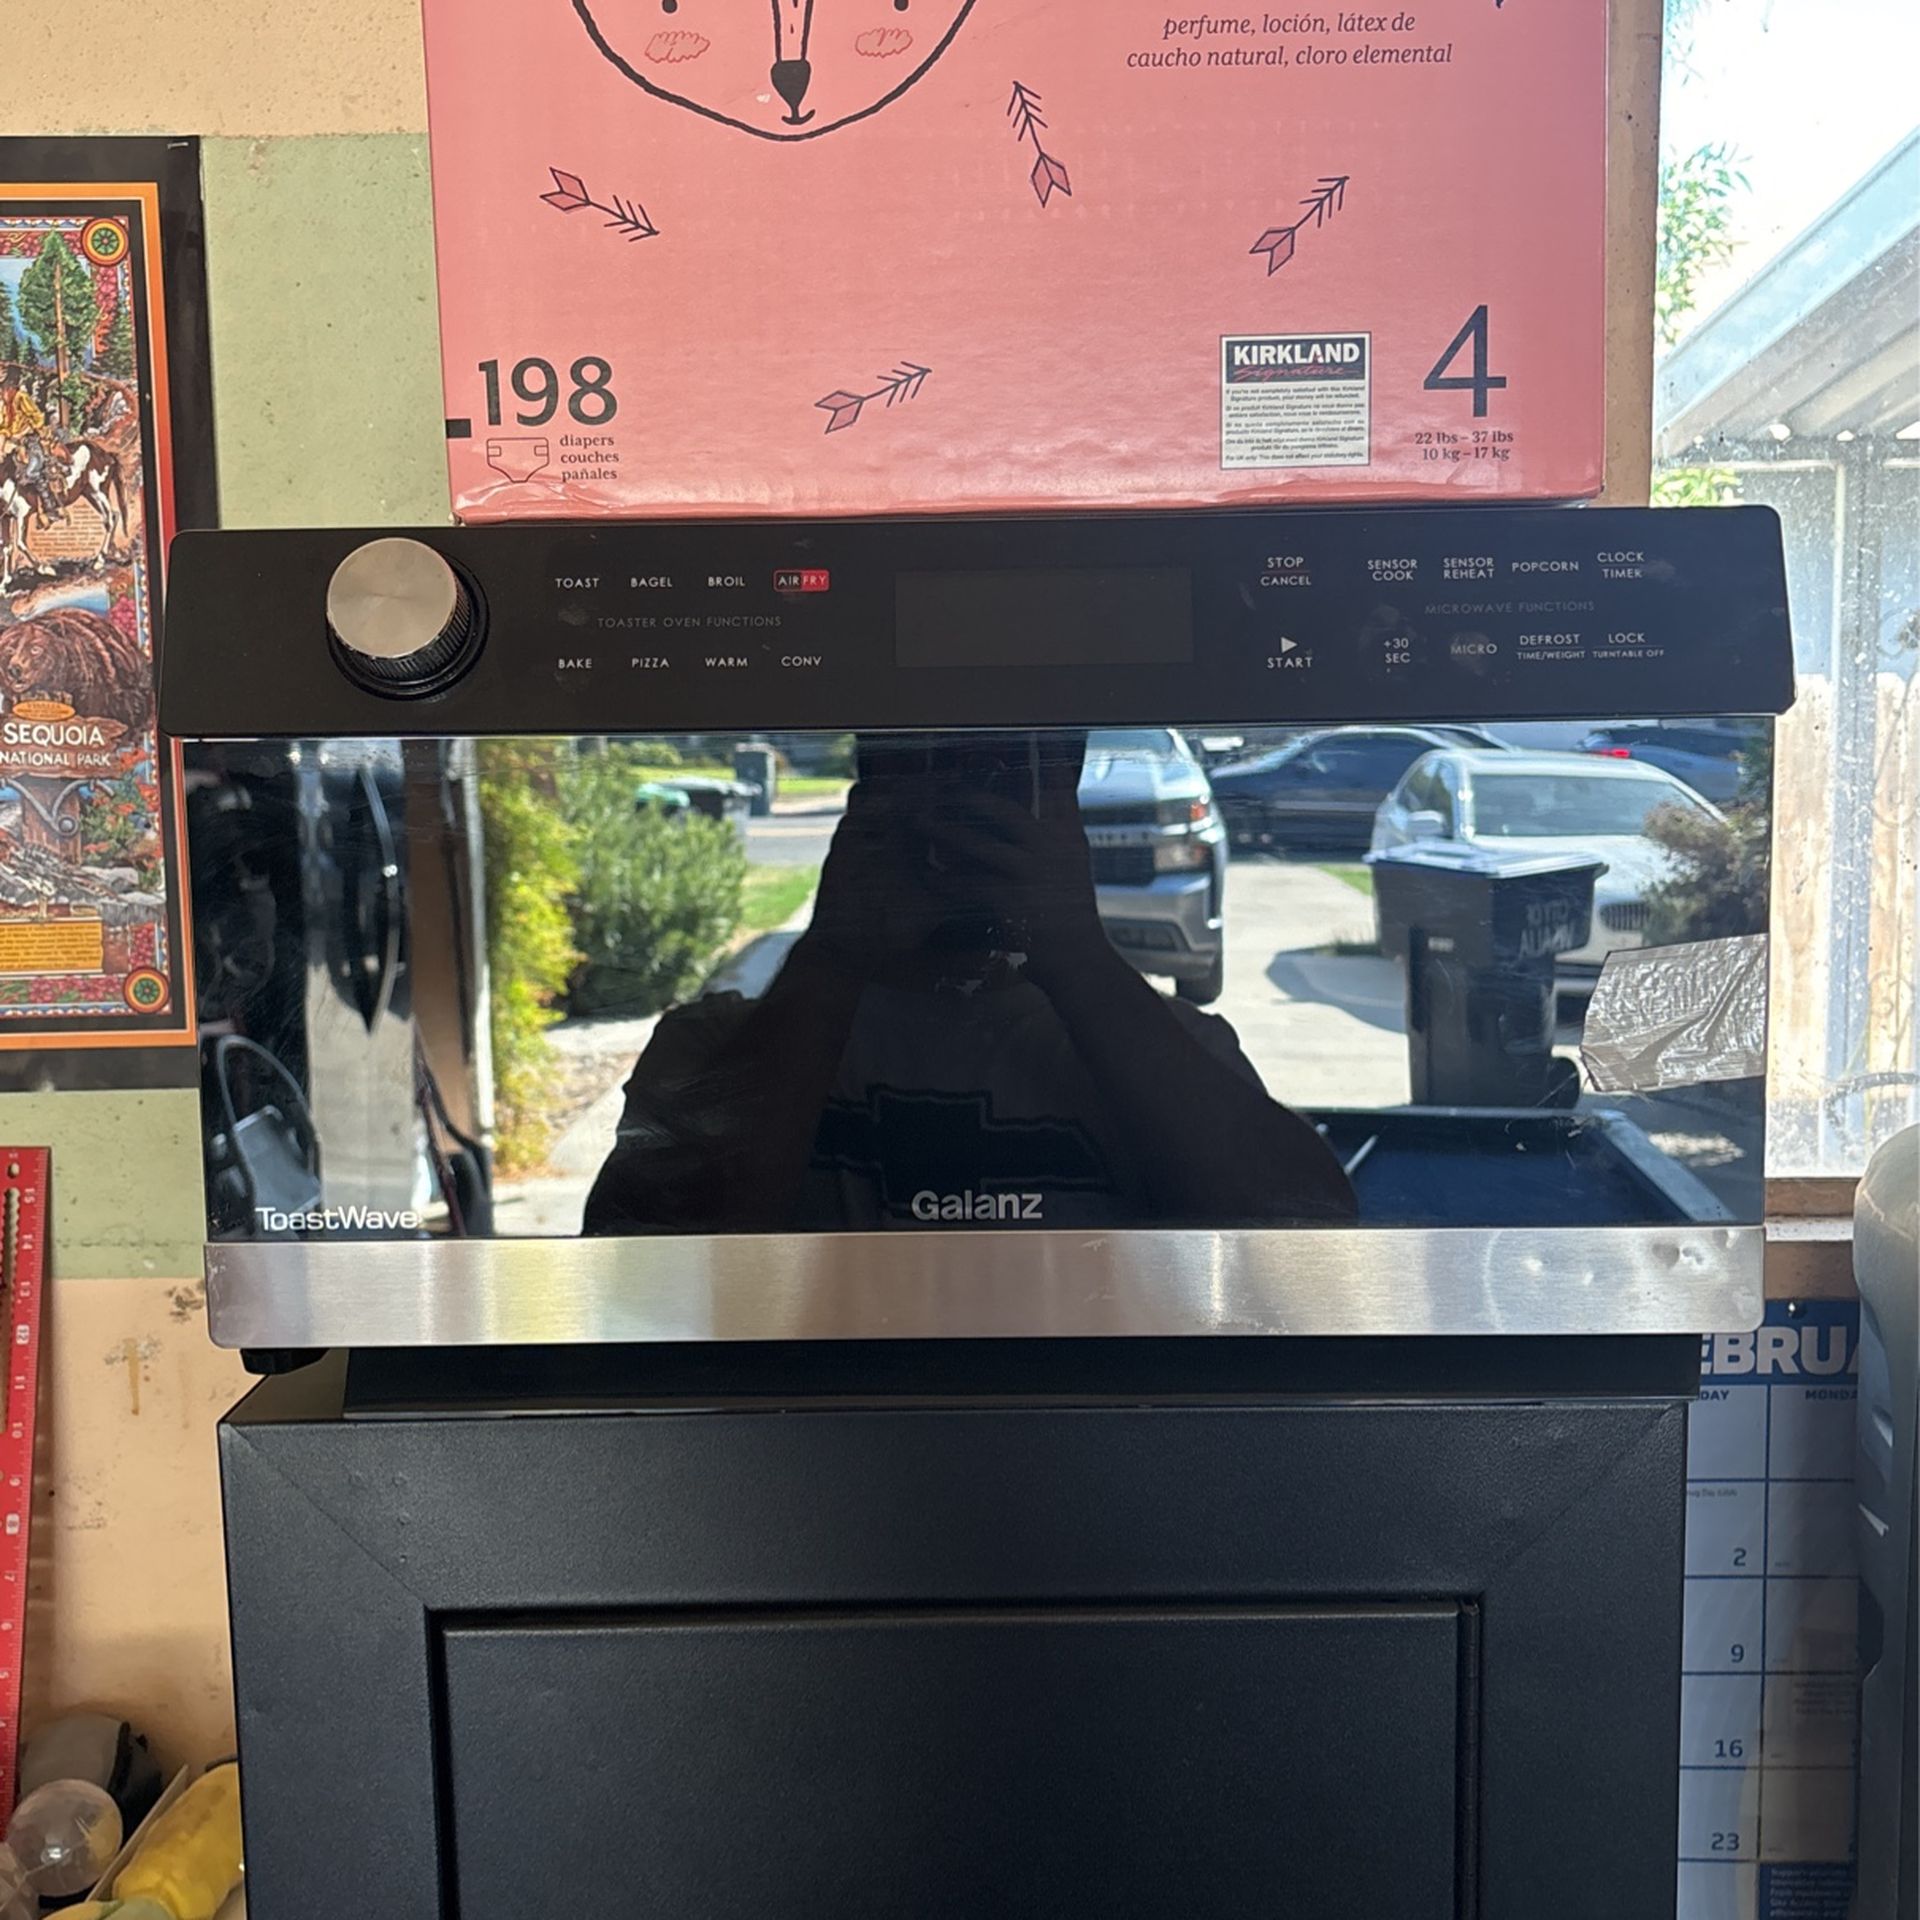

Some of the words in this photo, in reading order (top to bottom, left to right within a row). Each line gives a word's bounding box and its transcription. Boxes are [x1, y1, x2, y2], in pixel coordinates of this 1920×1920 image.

[1163, 14, 1256, 40] perfume,
[1262, 12, 1331, 35] loción,
[1338, 12, 1388, 33] látex
[1391, 12, 1416, 32] de
[1127, 47, 1202, 68] caucho
[1207, 46, 1289, 68] natural,
[1296, 45, 1347, 65] cloro
[1353, 44, 1452, 65] elemental
[1234, 342, 1360, 366] KIRKLAND
[1423, 304, 1507, 418] 4
[1234, 364, 1358, 383] Signature
[478, 356, 618, 427] 198
[559, 434, 615, 450] diapers
[1415, 432, 1432, 445] 22
[1436, 431, 1458, 445] lbs
[1472, 431, 1488, 444] 37
[1492, 430, 1514, 443] lbs
[560, 451, 620, 465] couches
[1423, 448, 1438, 460] 10
[1442, 447, 1461, 462] kg
[1475, 446, 1488, 459] 17
[1492, 446, 1510, 461] kg
[561, 468, 618, 483] pañales
[1267, 556, 1304, 569] STOP
[1443, 557, 1494, 568] SENSOR
[1597, 552, 1644, 563] CLOCK
[1367, 559, 1418, 570] SENSOR
[1512, 561, 1579, 572] POPCORN
[1372, 570, 1414, 581] COOK
[1444, 568, 1495, 580] REHEAT
[1603, 568, 1643, 579] TIMER
[555, 577, 600, 589] TOAST
[630, 576, 673, 588] BAGEL
[707, 576, 746, 587] BROIL
[1261, 575, 1312, 586] CANCEL
[1424, 602, 1513, 614] MICROWAVE
[1519, 600, 1595, 612] FUNCTIONS
[597, 617, 656, 628] TOASTER
[663, 616, 700, 628] OVEN
[707, 615, 782, 627] FUNCTIONS
[1384, 637, 1409, 649] +30
[1519, 633, 1581, 645] DEFROST
[1608, 633, 1645, 644] LOCK
[1451, 643, 1497, 654] MICRO
[1593, 650, 1643, 659] TURNTABLE
[1646, 649, 1664, 658] OFF
[1385, 652, 1410, 664] SEC
[1517, 650, 1586, 660] TIME/WEIGHT
[558, 657, 593, 669] BAKE
[631, 657, 670, 668] PIZZA
[704, 657, 748, 668] WARM
[781, 656, 822, 667] CONV
[1267, 657, 1313, 668] START
[3, 721, 105, 747] SEQUOIA
[0, 750, 71, 766] NATIONAL
[77, 752, 112, 767] PARK
[911, 1189, 1043, 1221] Galanz
[255, 1205, 418, 1232] ToastWave
[1699, 1389, 1730, 1400] DAY
[1805, 1388, 1858, 1400] MONDA
[1733, 1547, 1747, 1567] 2
[1730, 1643, 1745, 1663] 9
[1714, 1739, 1744, 1758] 16
[1711, 1832, 1740, 1851] 23
